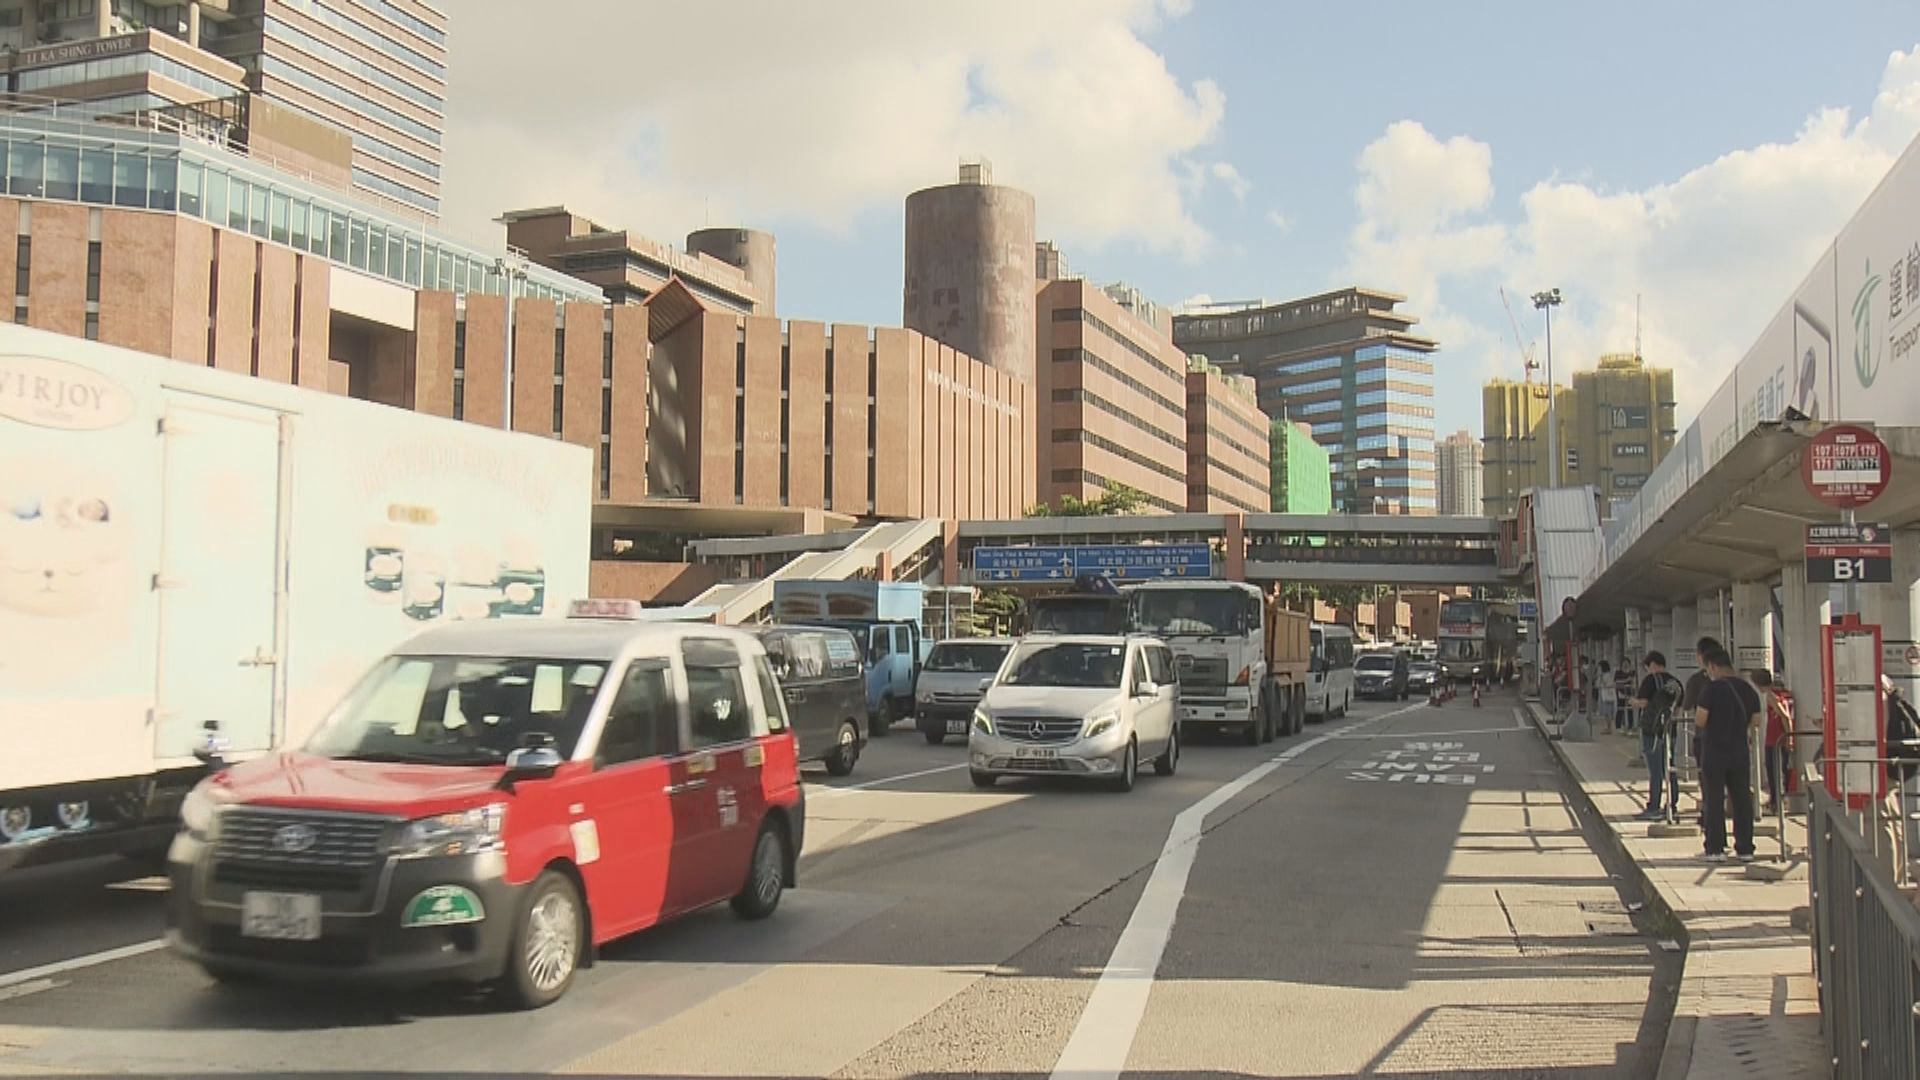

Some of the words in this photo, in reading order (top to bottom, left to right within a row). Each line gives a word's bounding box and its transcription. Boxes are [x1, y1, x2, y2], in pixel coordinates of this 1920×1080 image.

[26, 53, 37, 64] LI
[40, 50, 56, 62] KA
[58, 44, 92, 58] SHING
[95, 38, 132, 54] TOWER
[1625, 446, 1644, 454] MTR
[1815, 445, 1831, 456] 107
[1860, 444, 1877, 456] 170
[1815, 458, 1831, 469] 171
[1834, 558, 1865, 579] B1
[1345, 772, 1477, 785] BUS
